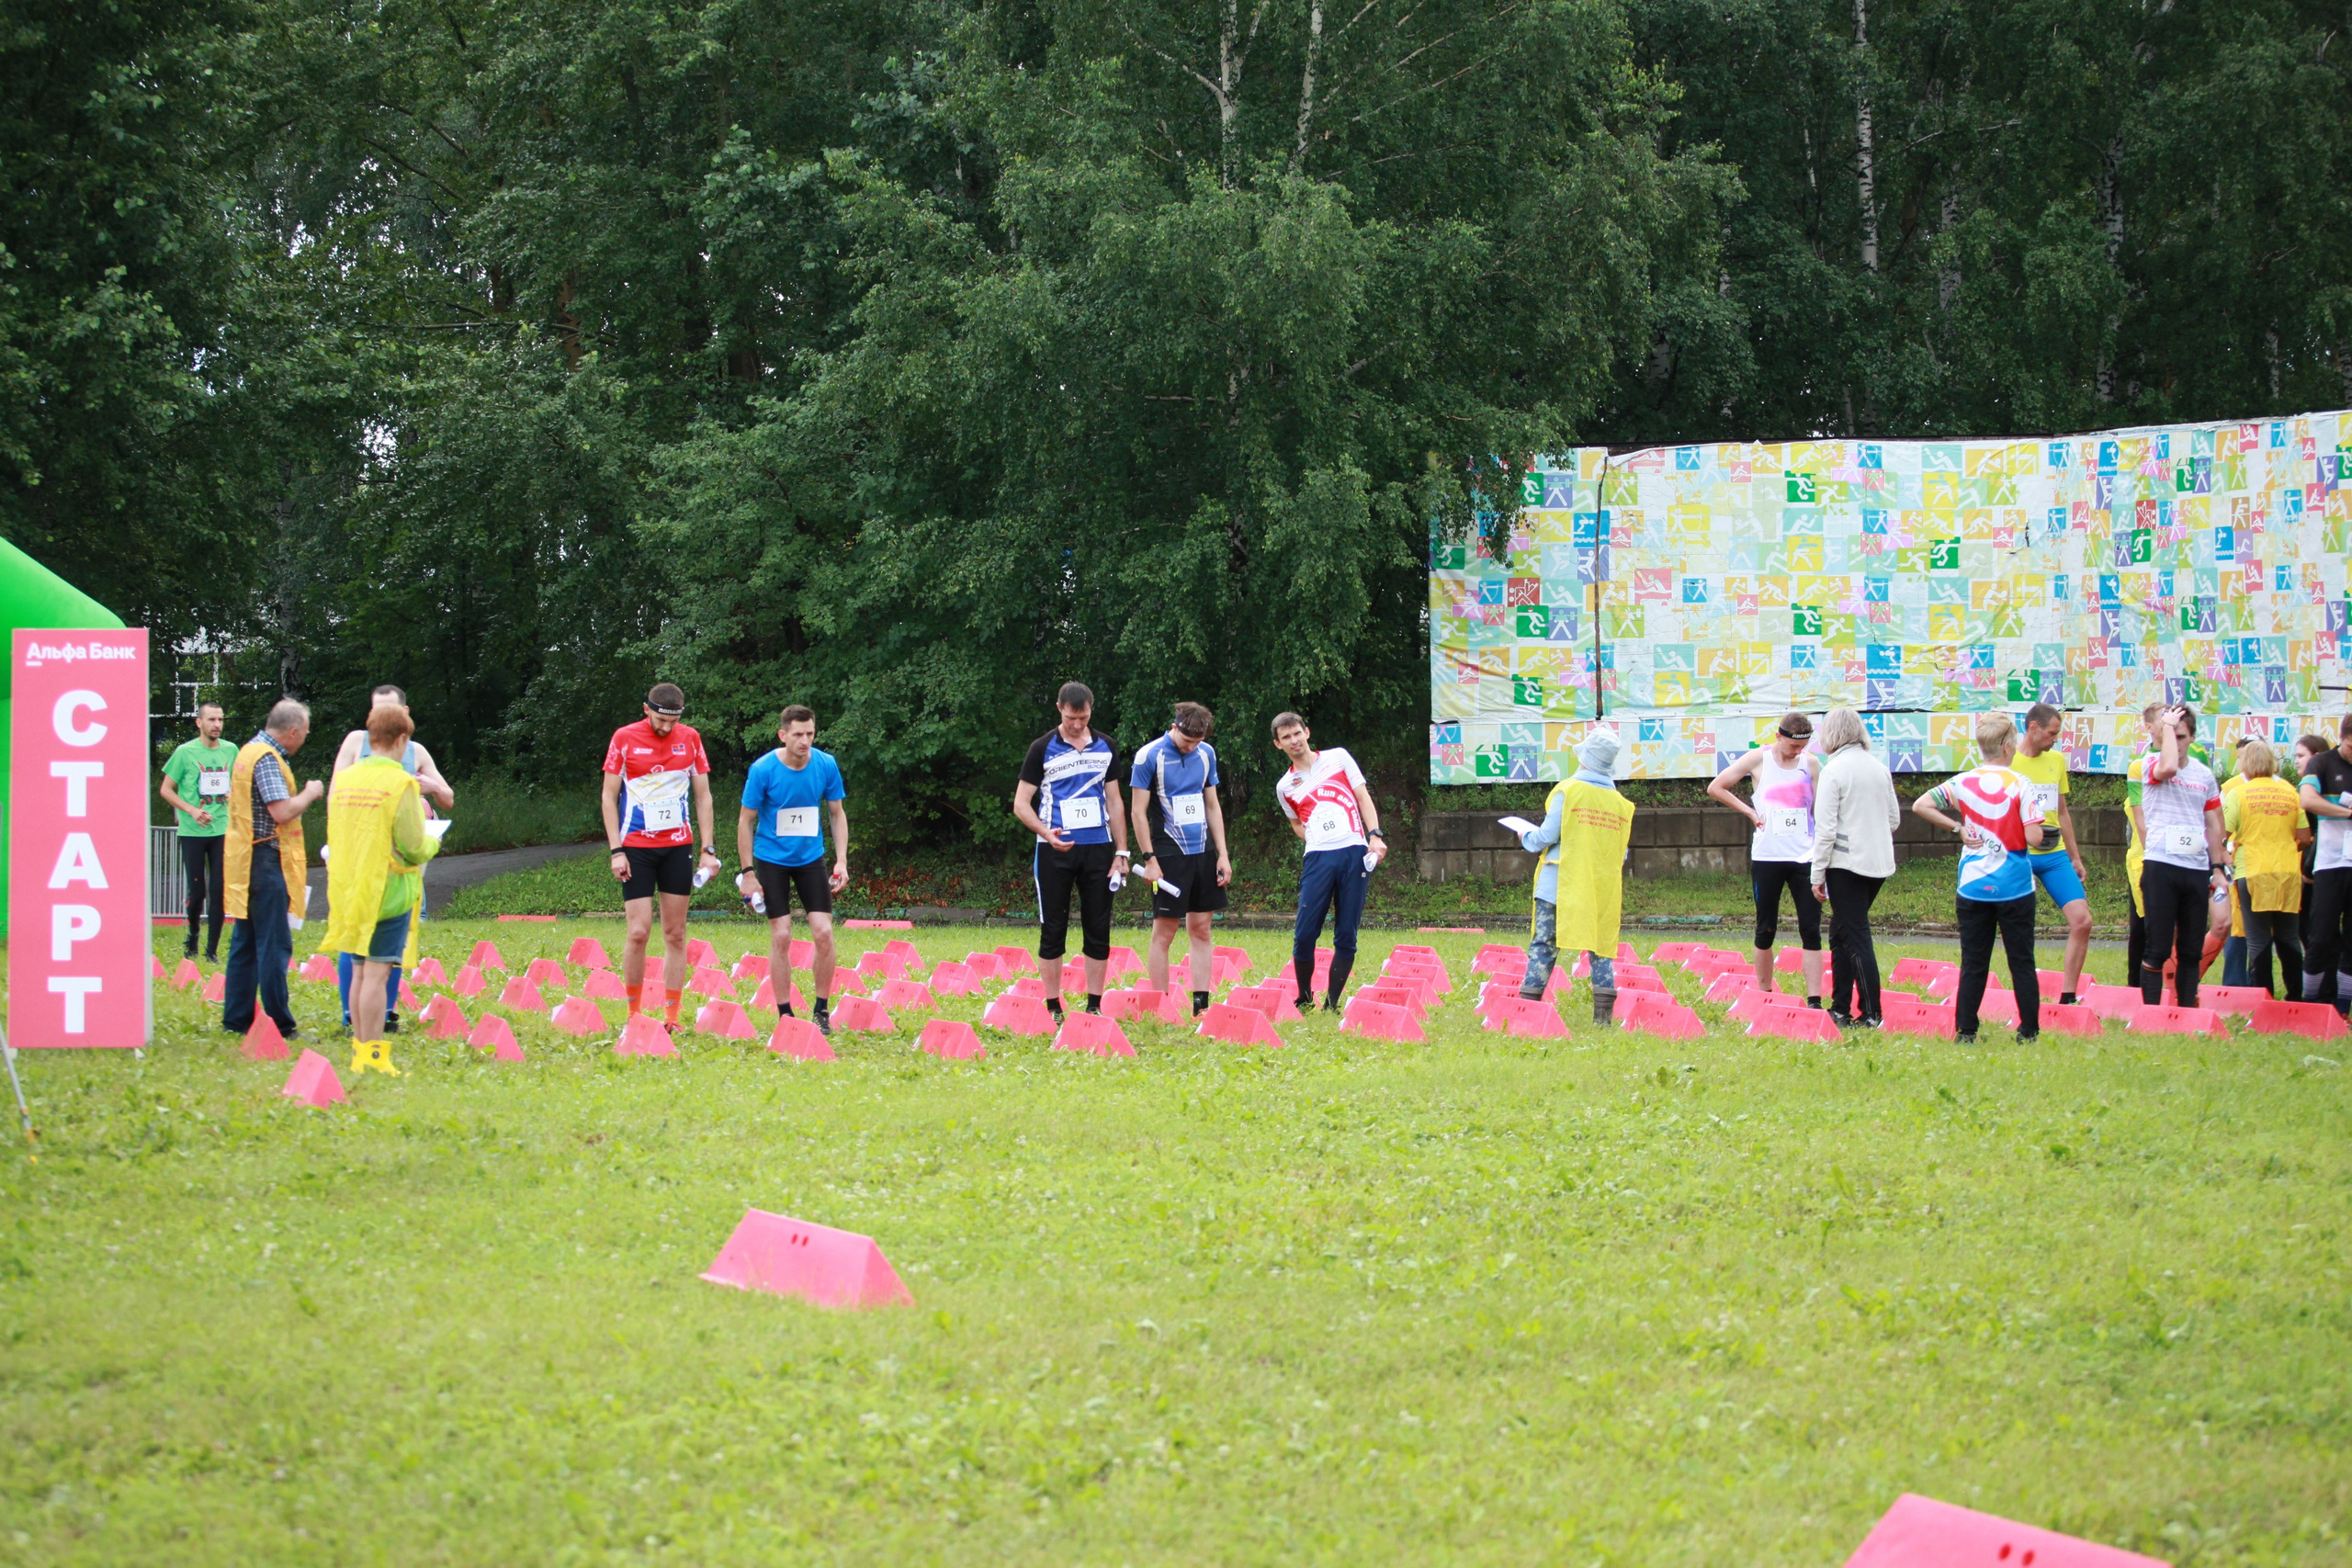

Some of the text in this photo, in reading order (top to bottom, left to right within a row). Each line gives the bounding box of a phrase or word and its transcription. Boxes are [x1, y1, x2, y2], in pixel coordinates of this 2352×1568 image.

[26, 642, 136, 665] Альфа Банк
[1049, 759, 1108, 775] ORIENTEERING
[1317, 788, 1335, 797] Run
[1337, 794, 1353, 808] and
[658, 809, 672, 820] 72
[1075, 808, 1087, 818] 70
[1185, 805, 1195, 815] 69
[790, 814, 802, 824] 71
[1785, 818, 1796, 827] 64
[1323, 820, 1335, 831] 68
[2179, 836, 2191, 846] 52
[47, 689, 109, 1033] СТАРТ
